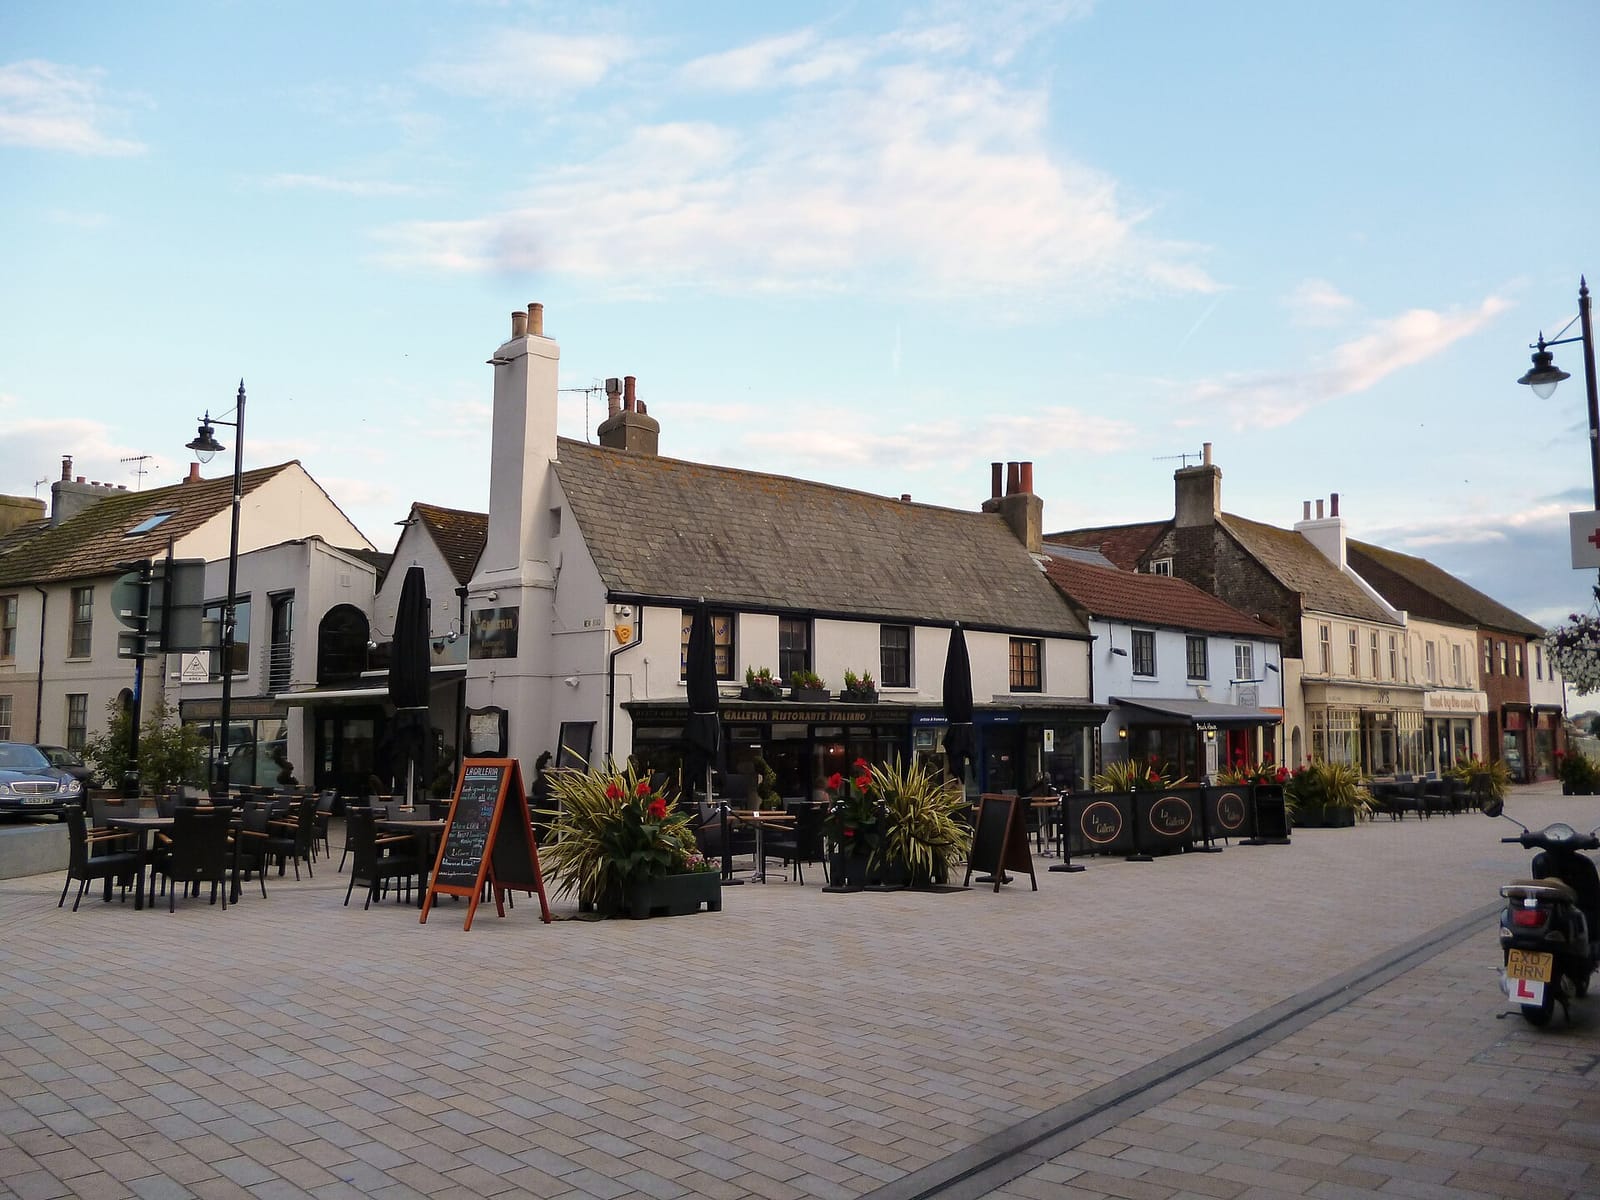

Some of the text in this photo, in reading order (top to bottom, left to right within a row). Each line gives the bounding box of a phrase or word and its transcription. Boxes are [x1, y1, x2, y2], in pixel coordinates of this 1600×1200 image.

[723, 711, 767, 721] GALLERIA
[772, 711, 826, 720] RISTORANTE
[829, 711, 866, 721] ITALIANO
[1511, 951, 1551, 965] GX07
[1514, 964, 1544, 979] HRN
[1517, 979, 1535, 998] L
